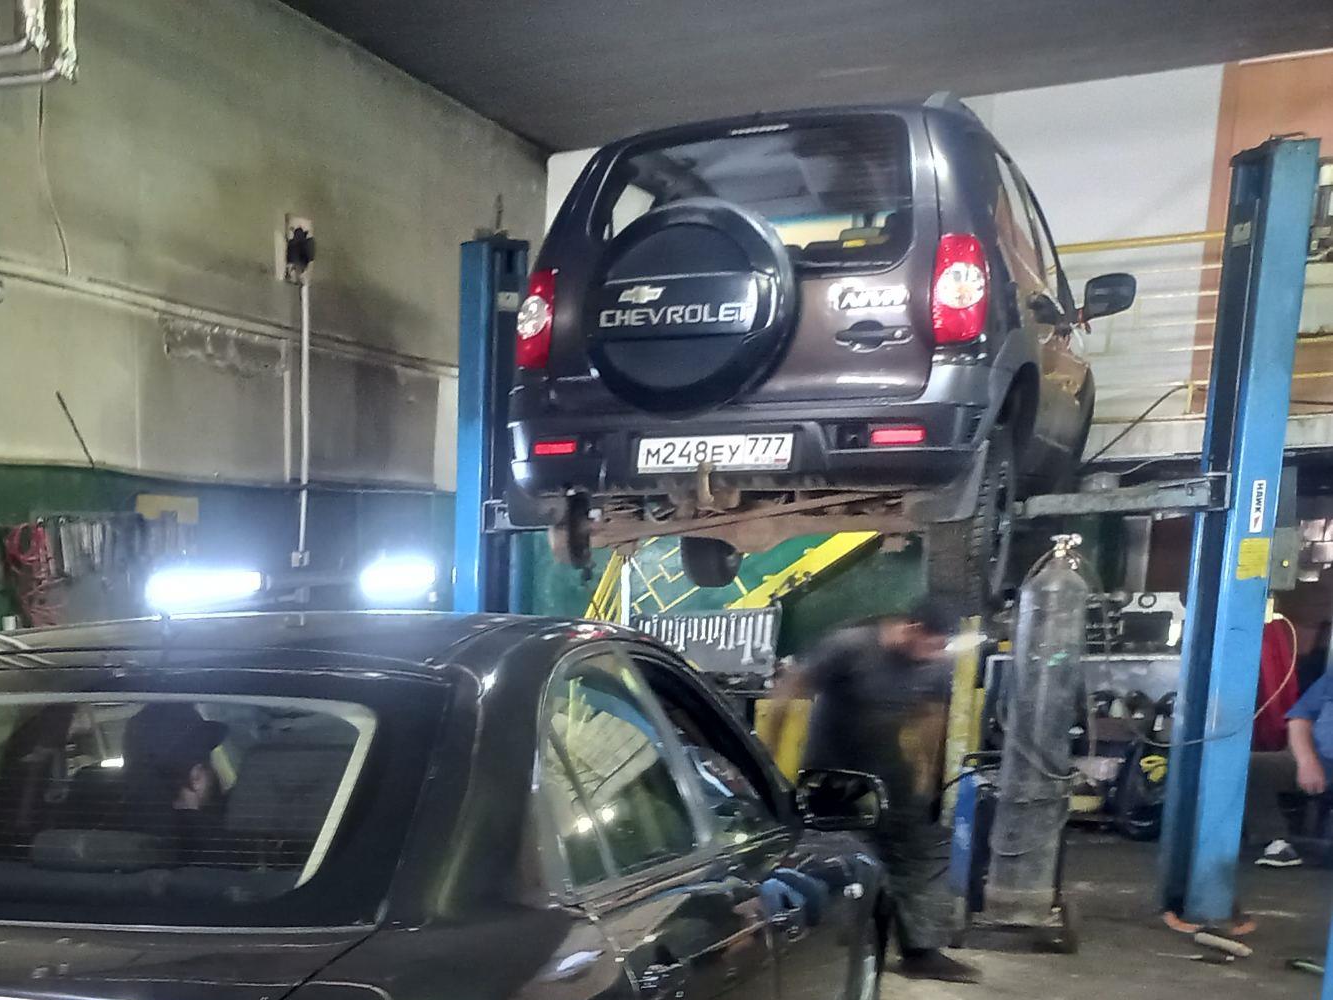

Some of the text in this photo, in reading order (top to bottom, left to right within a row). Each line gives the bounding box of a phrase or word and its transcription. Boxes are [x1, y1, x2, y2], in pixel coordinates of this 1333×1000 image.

[599, 302, 750, 328] CHEVROLET
[644, 437, 785, 465] М248ЕУ 777
[1254, 483, 1264, 513] HAWK
